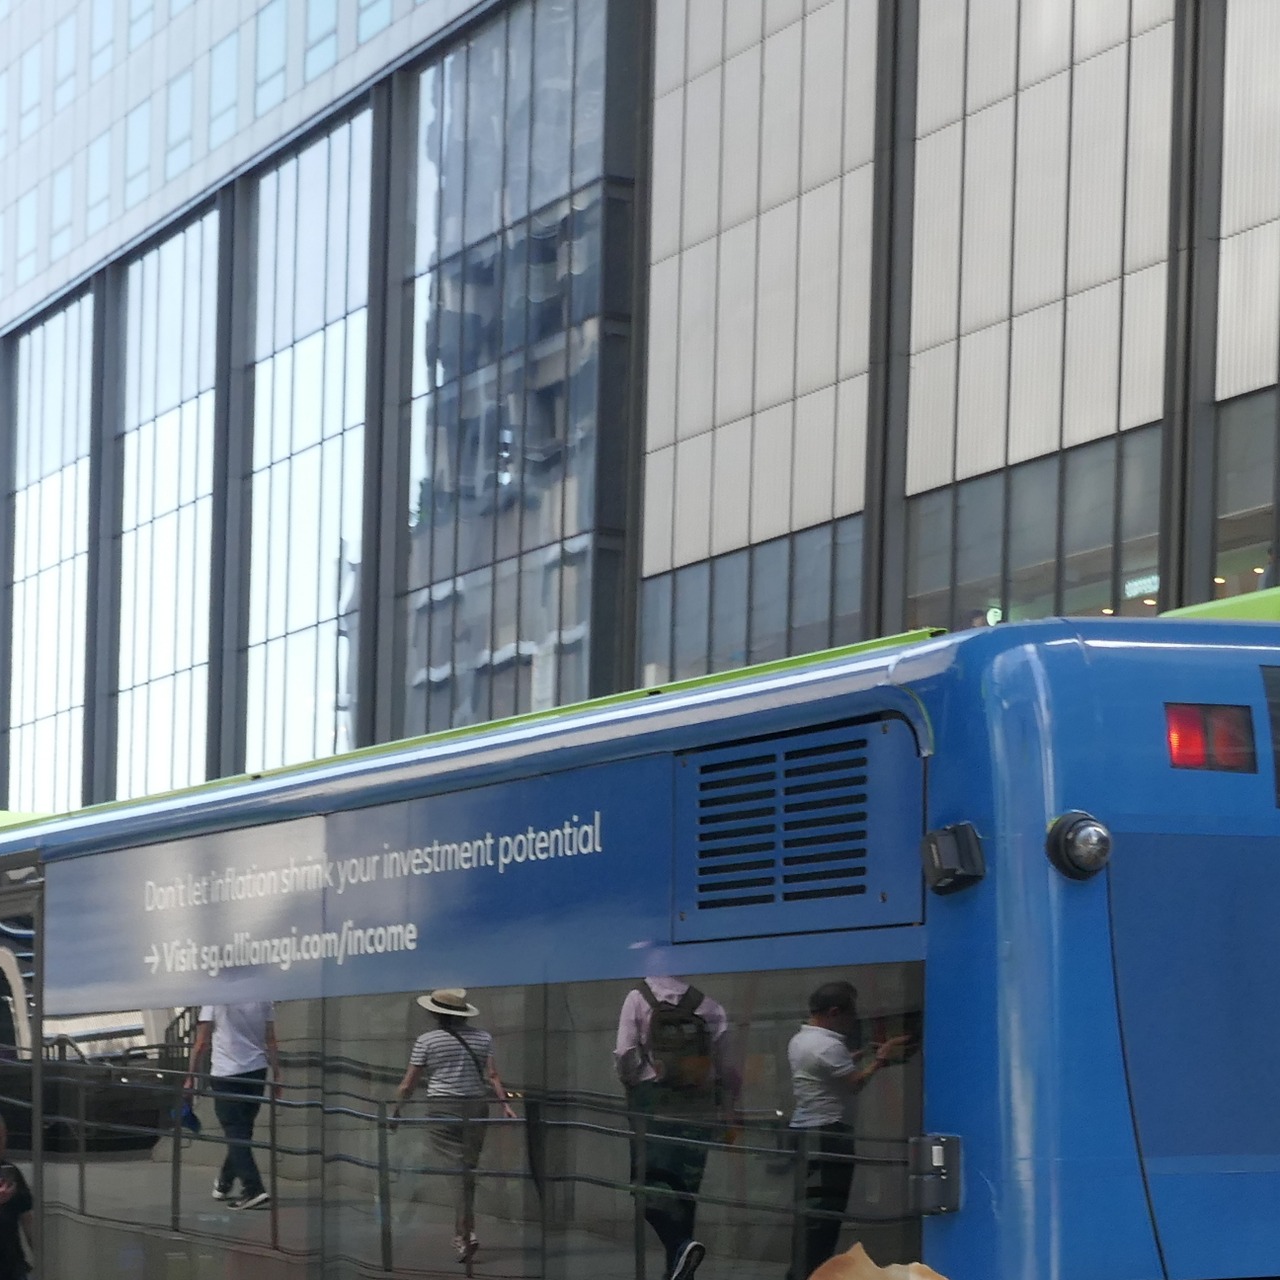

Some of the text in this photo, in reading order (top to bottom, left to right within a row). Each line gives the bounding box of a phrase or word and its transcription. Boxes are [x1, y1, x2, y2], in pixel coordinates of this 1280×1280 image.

[144, 811, 602, 912] Don't let inflation shrink your investment potential
[161, 918, 418, 977] Visit sg.allianzgi.com/income
